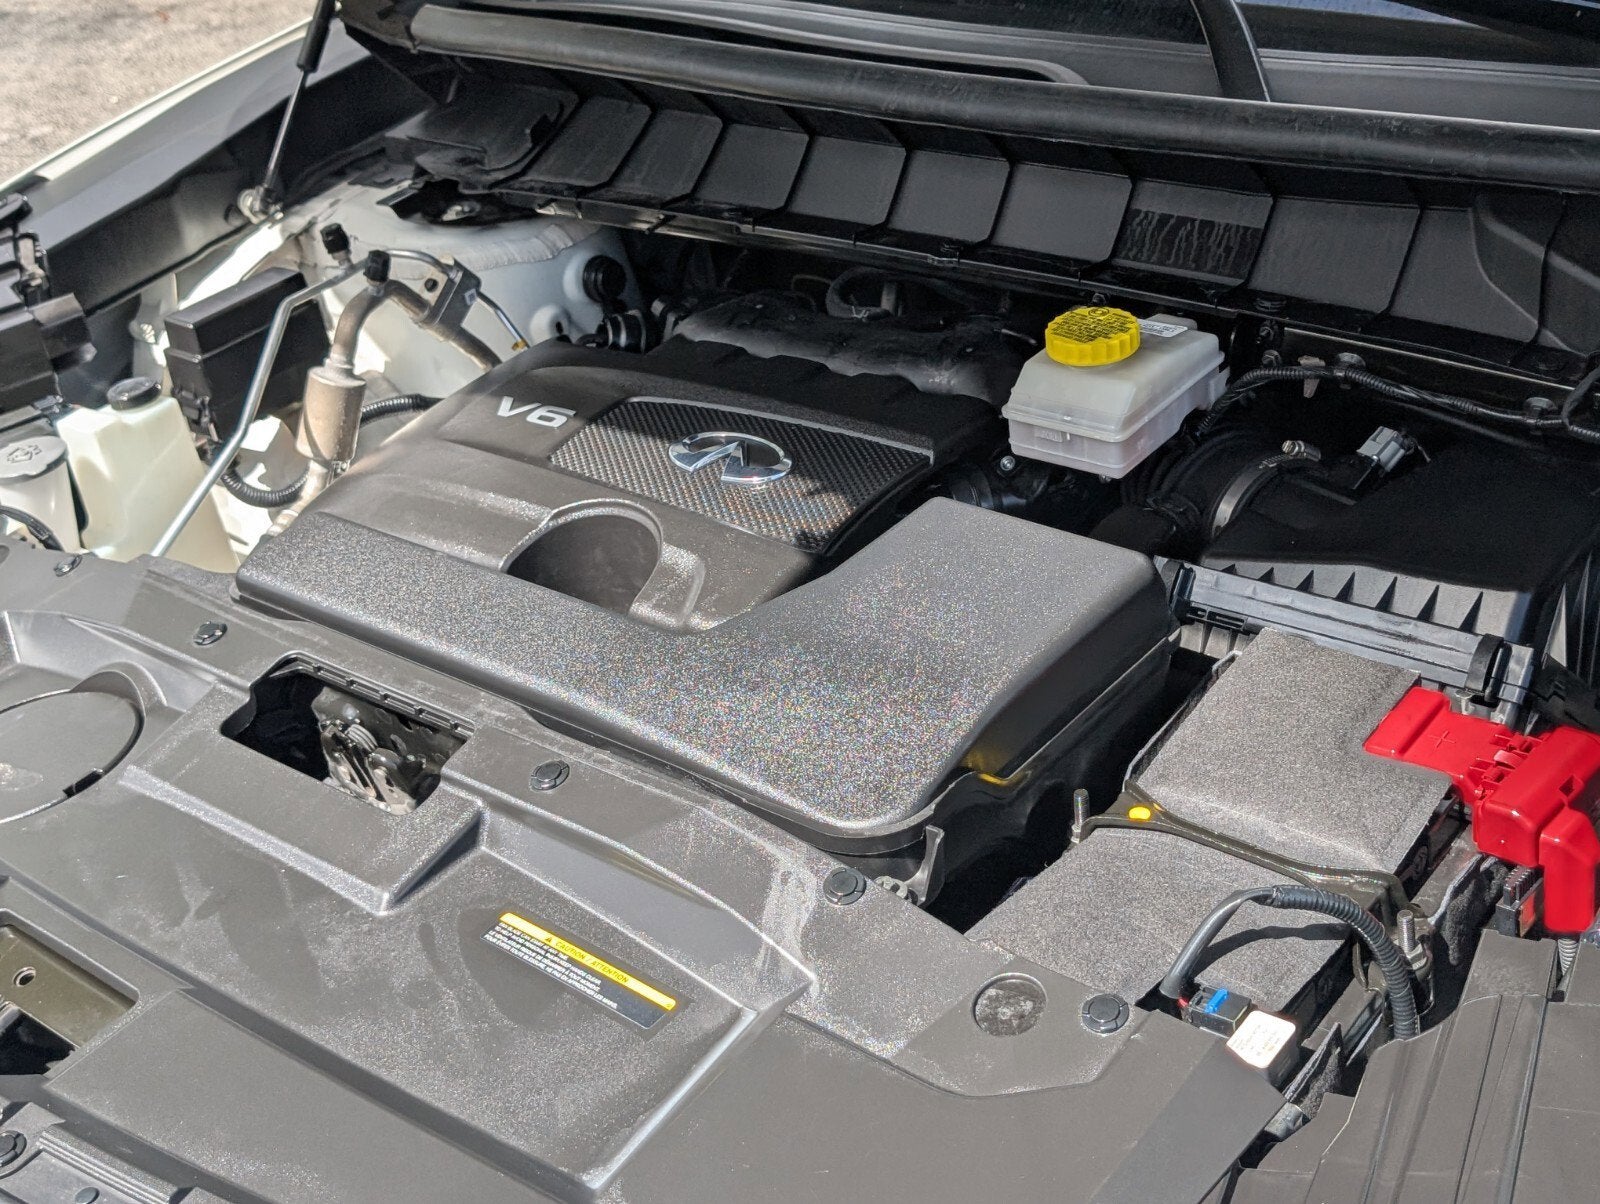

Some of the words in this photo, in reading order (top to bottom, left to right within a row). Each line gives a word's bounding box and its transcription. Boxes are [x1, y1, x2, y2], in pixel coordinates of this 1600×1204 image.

[497, 395, 577, 427] V6
[555, 940, 586, 960] CAUTION
[590, 960, 629, 982] ATTENTION
